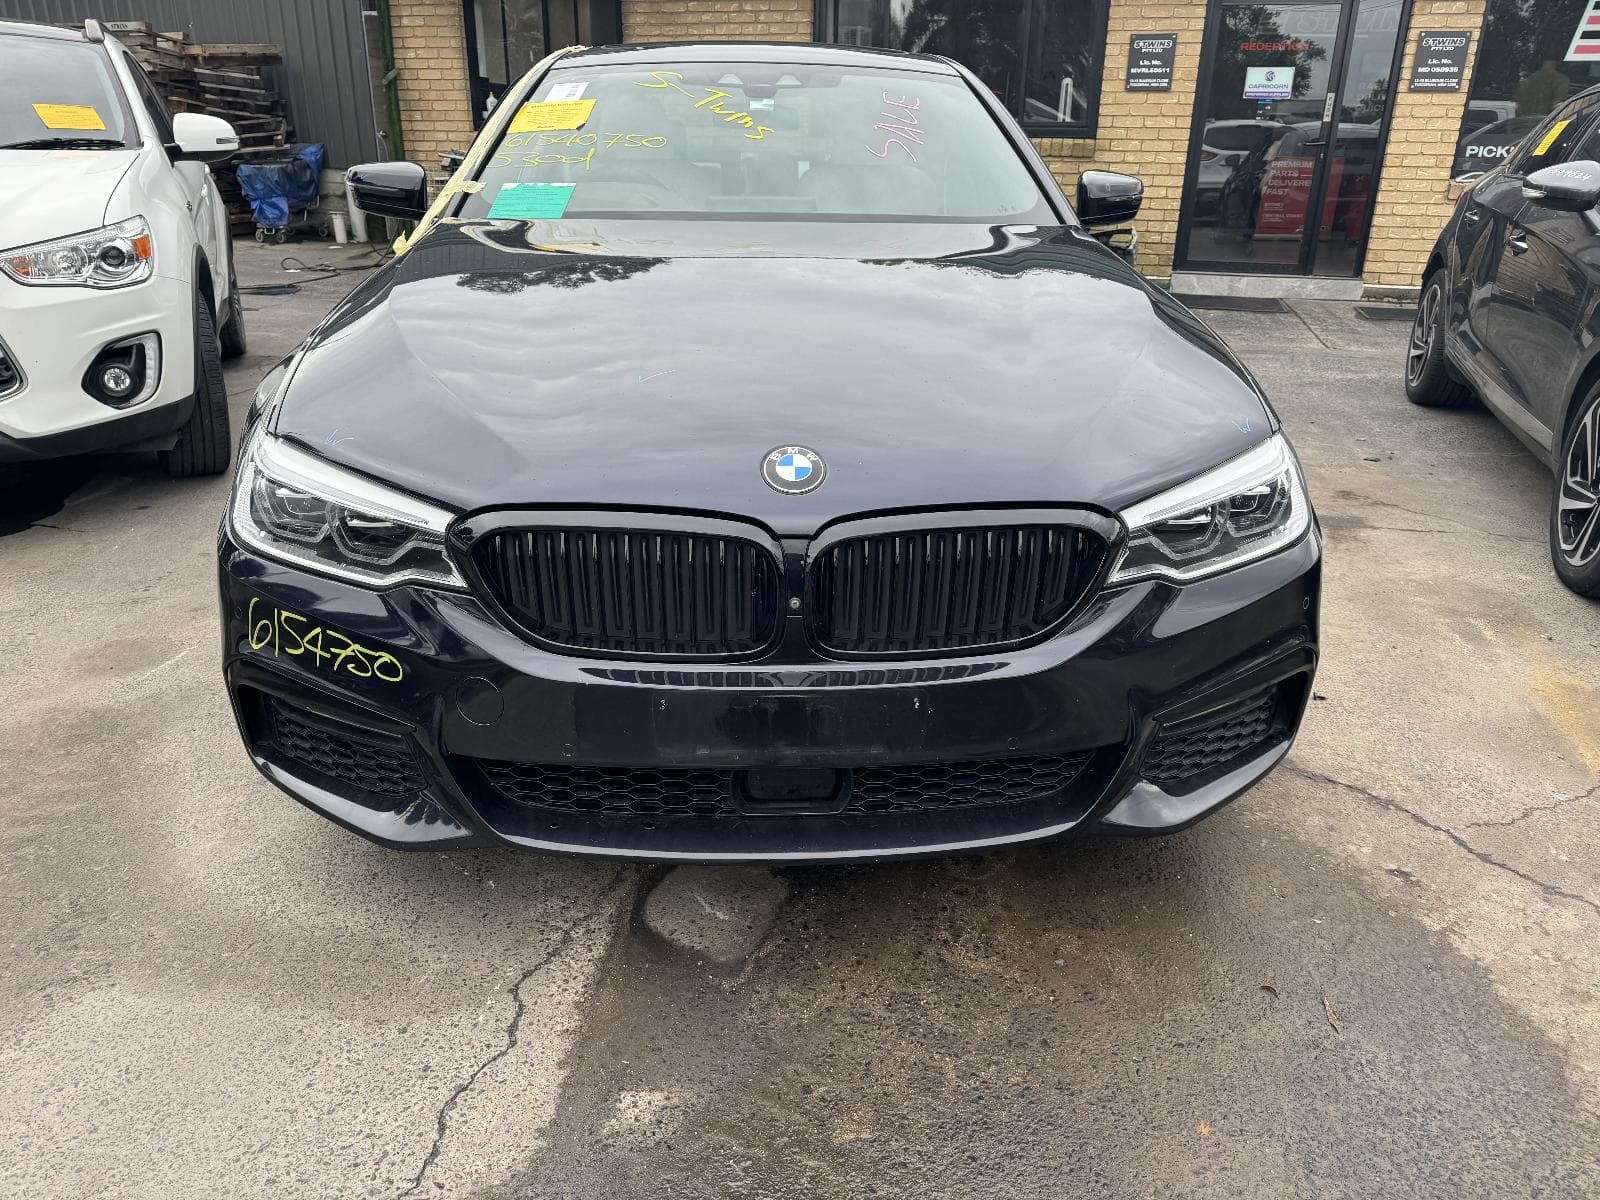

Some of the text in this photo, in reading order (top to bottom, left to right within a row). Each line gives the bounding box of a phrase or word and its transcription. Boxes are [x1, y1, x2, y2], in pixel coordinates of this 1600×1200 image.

[864, 91, 925, 162] SALE
[1465, 145, 1514, 158] PICK
[1271, 160, 1313, 168] PREMIUM
[1267, 179, 1312, 187] DELIVERE
[248, 597, 403, 682] 6154750
